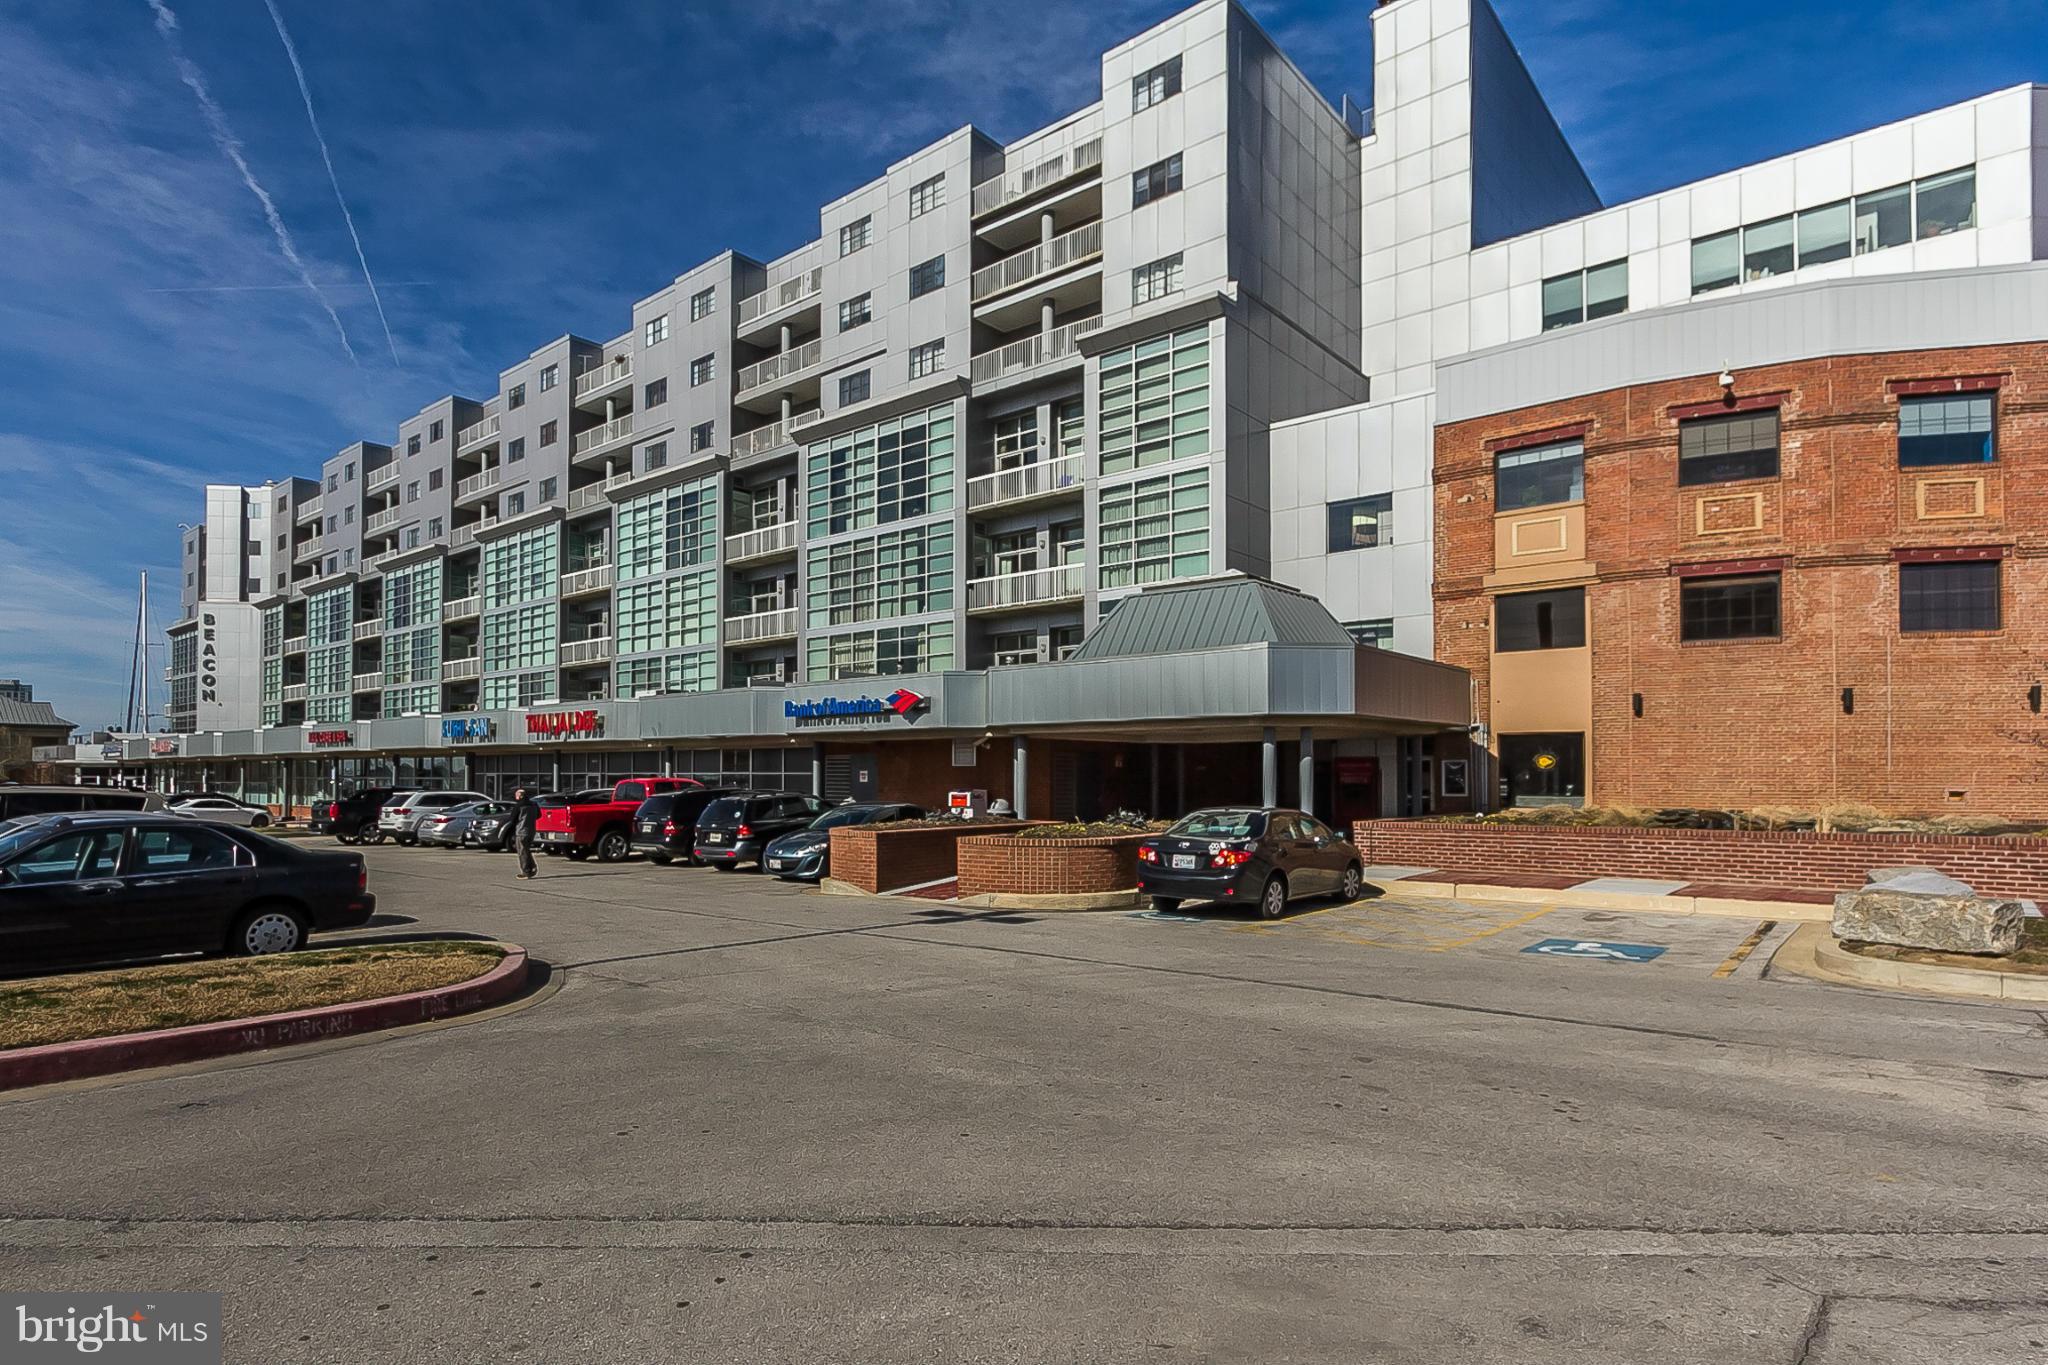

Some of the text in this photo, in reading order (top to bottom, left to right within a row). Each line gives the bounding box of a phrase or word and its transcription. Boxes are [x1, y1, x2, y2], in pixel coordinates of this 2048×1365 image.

[201, 613, 217, 702] BEACON
[784, 699, 816, 718] Bank
[829, 695, 882, 714] America
